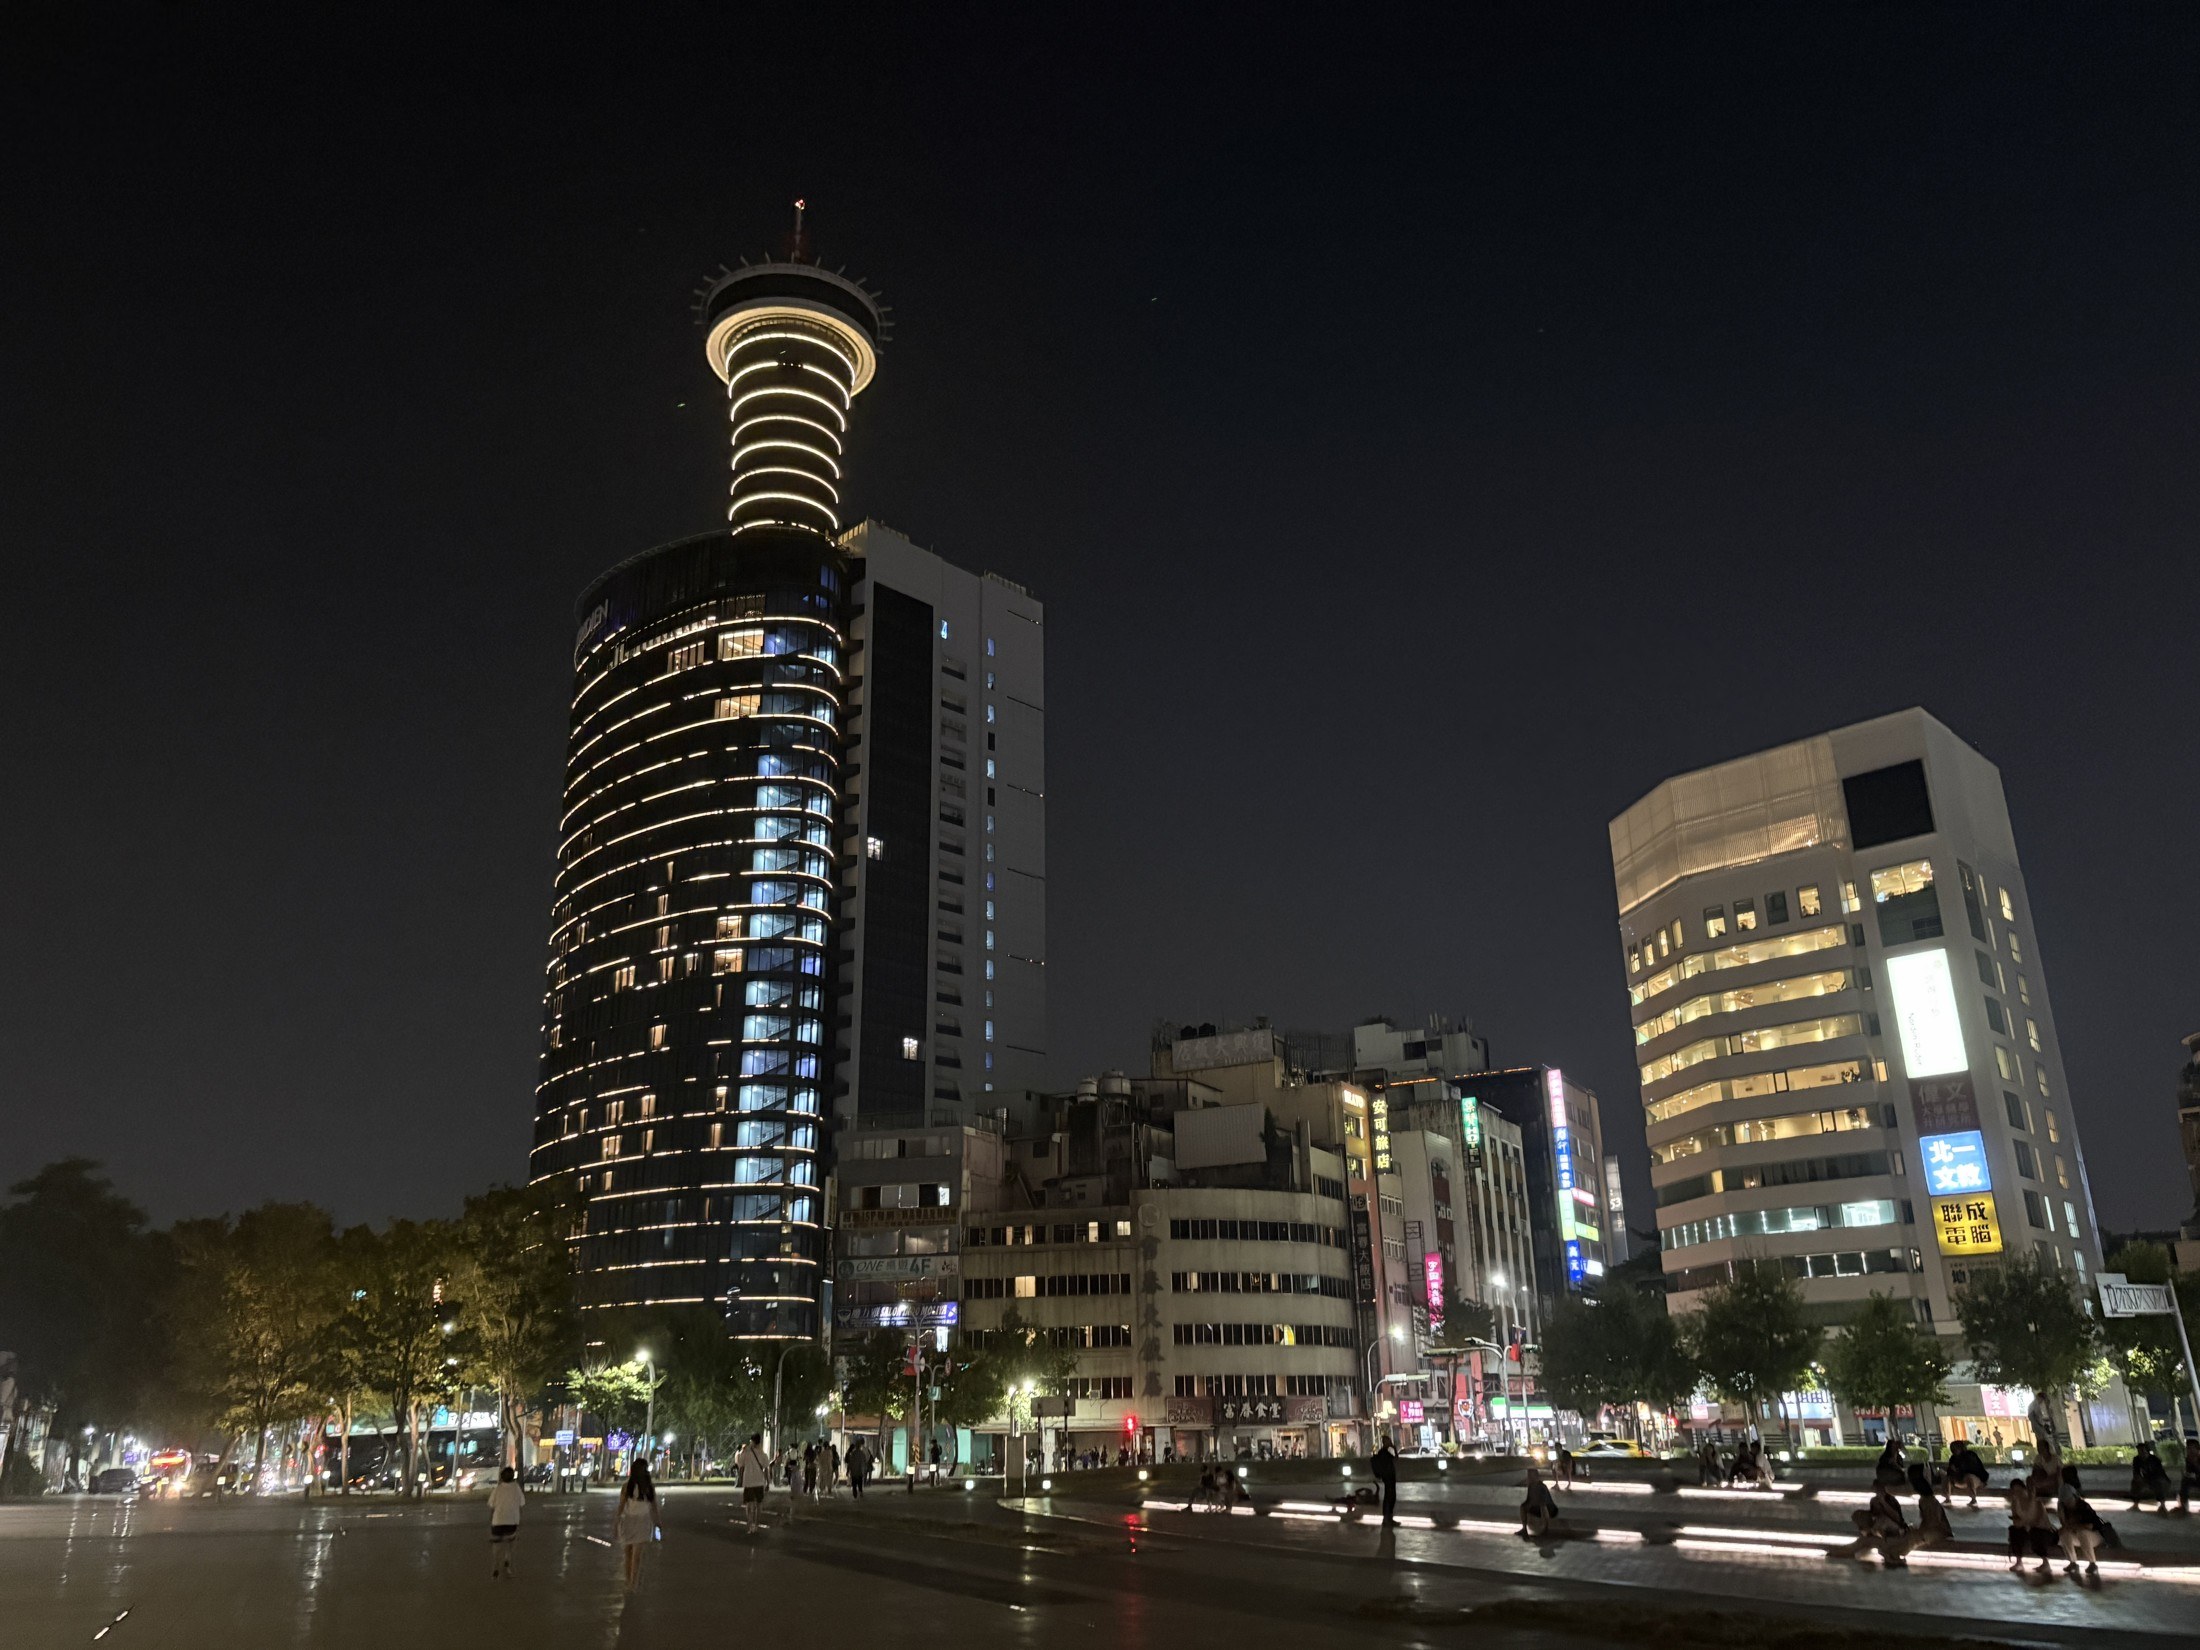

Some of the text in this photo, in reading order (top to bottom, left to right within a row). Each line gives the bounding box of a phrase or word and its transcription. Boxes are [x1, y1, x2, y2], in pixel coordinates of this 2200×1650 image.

[1372, 1099, 1391, 1169] 安可旅店
[1929, 1140, 1976, 1163] 北一
[1933, 1163, 1982, 1189] 文教
[1941, 1202, 1988, 1222] 聯成
[1945, 1224, 1992, 1245] 電腦
[856, 1260, 885, 1272] ONE
